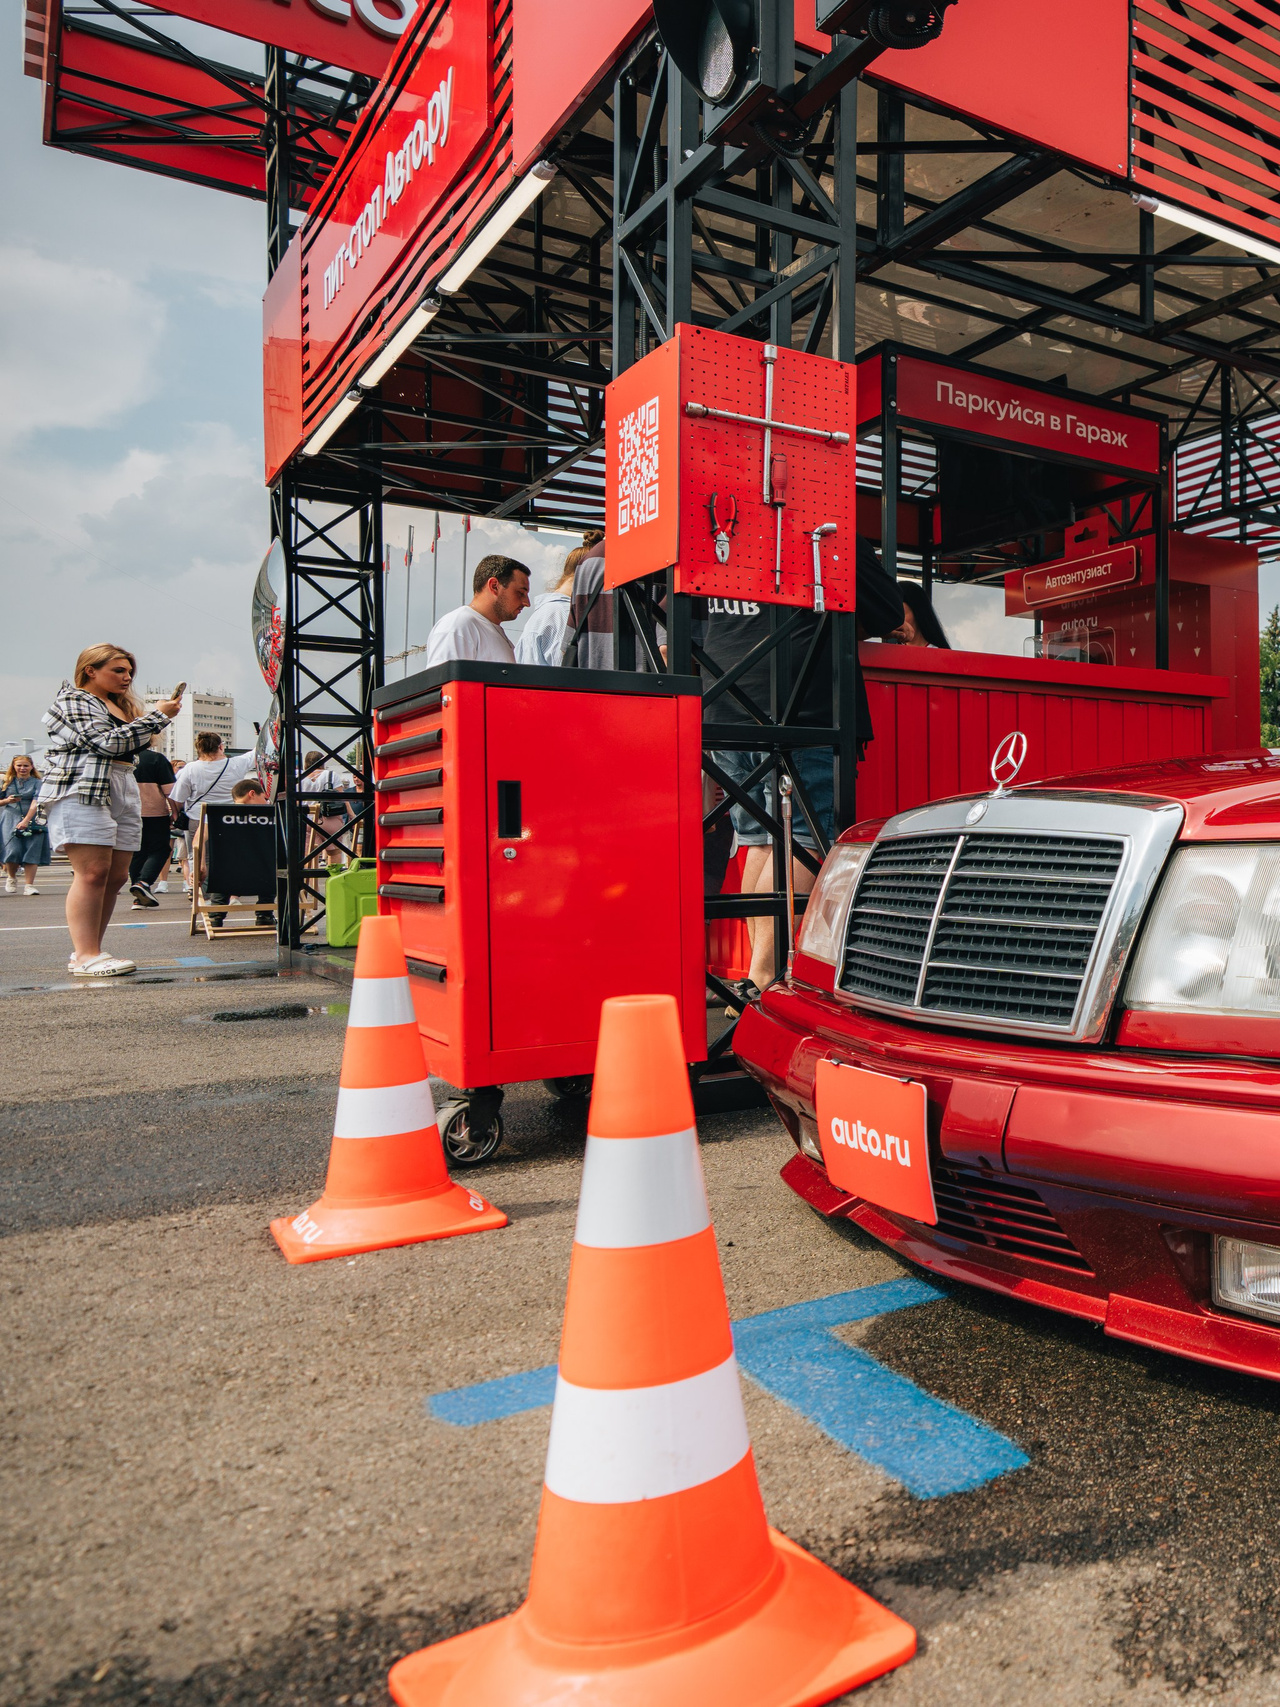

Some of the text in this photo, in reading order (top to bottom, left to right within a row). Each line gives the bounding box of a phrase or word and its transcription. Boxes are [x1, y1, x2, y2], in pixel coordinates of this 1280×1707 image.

[323, 65, 455, 310] пит-стоп Авто.ру
[936, 380, 1129, 449] Паркуйся в Гараж
[1044, 562, 1113, 589] Автоэнтузиаст
[1061, 615, 1098, 632] auto.ru
[222, 813, 277, 825] auto.
[93, 968, 117, 976] crocs
[831, 1116, 911, 1168] auto.ru
